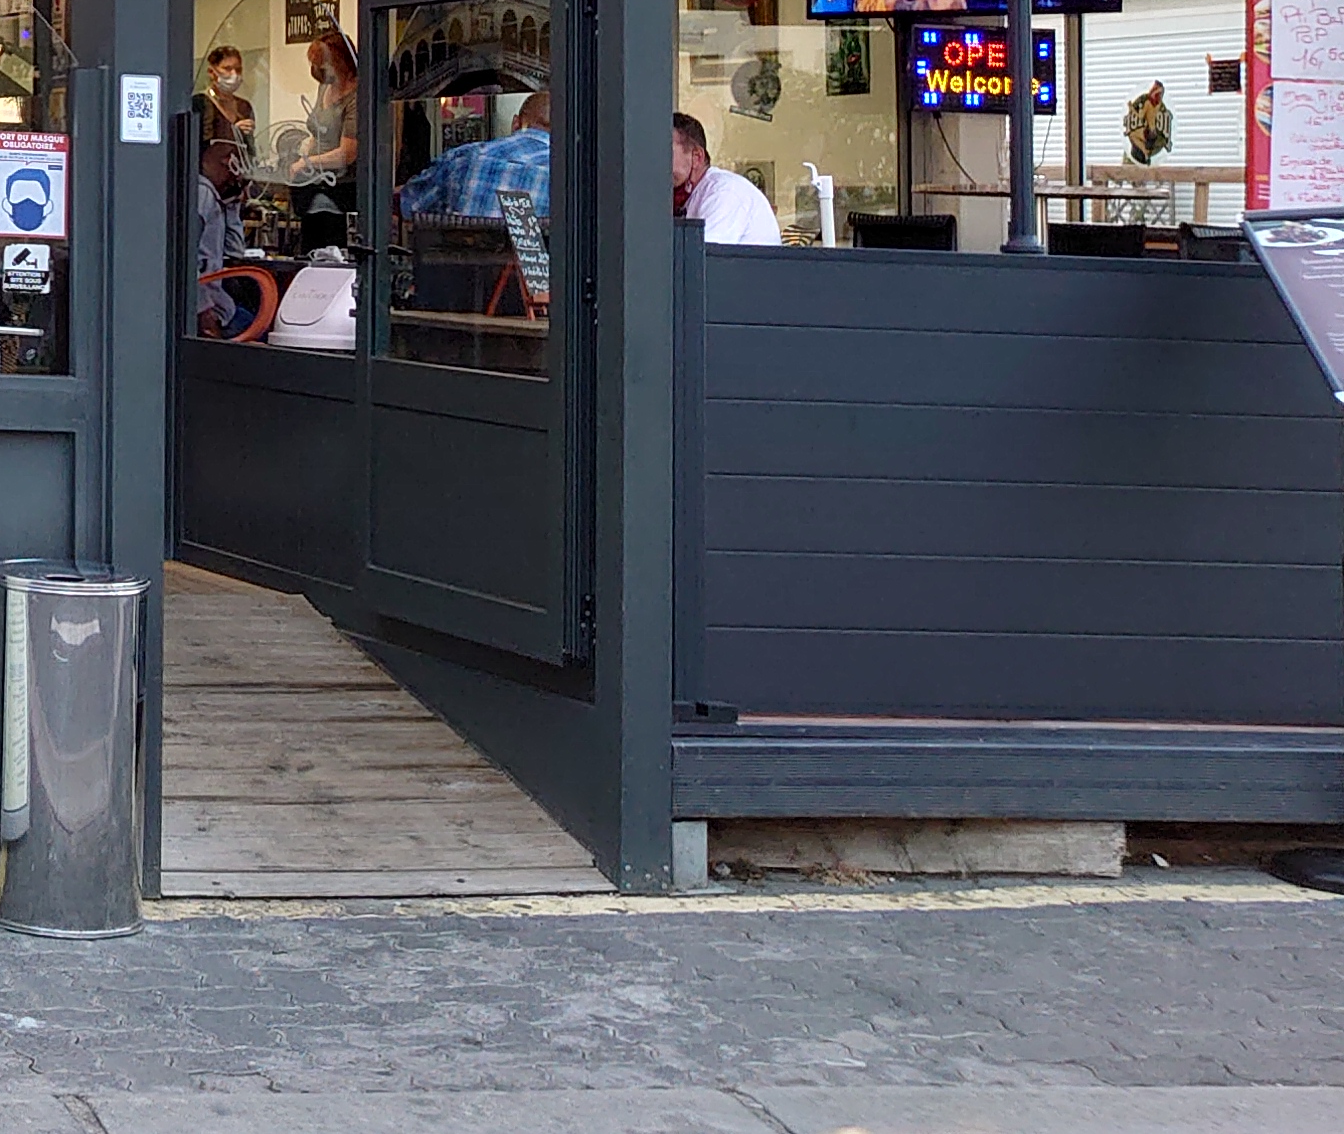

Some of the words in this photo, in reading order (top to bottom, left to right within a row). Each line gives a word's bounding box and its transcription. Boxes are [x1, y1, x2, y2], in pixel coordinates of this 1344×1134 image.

[944, 42, 1006, 67] OPE
[17, 134, 29, 142] DU
[30, 135, 65, 144] MASQUE
